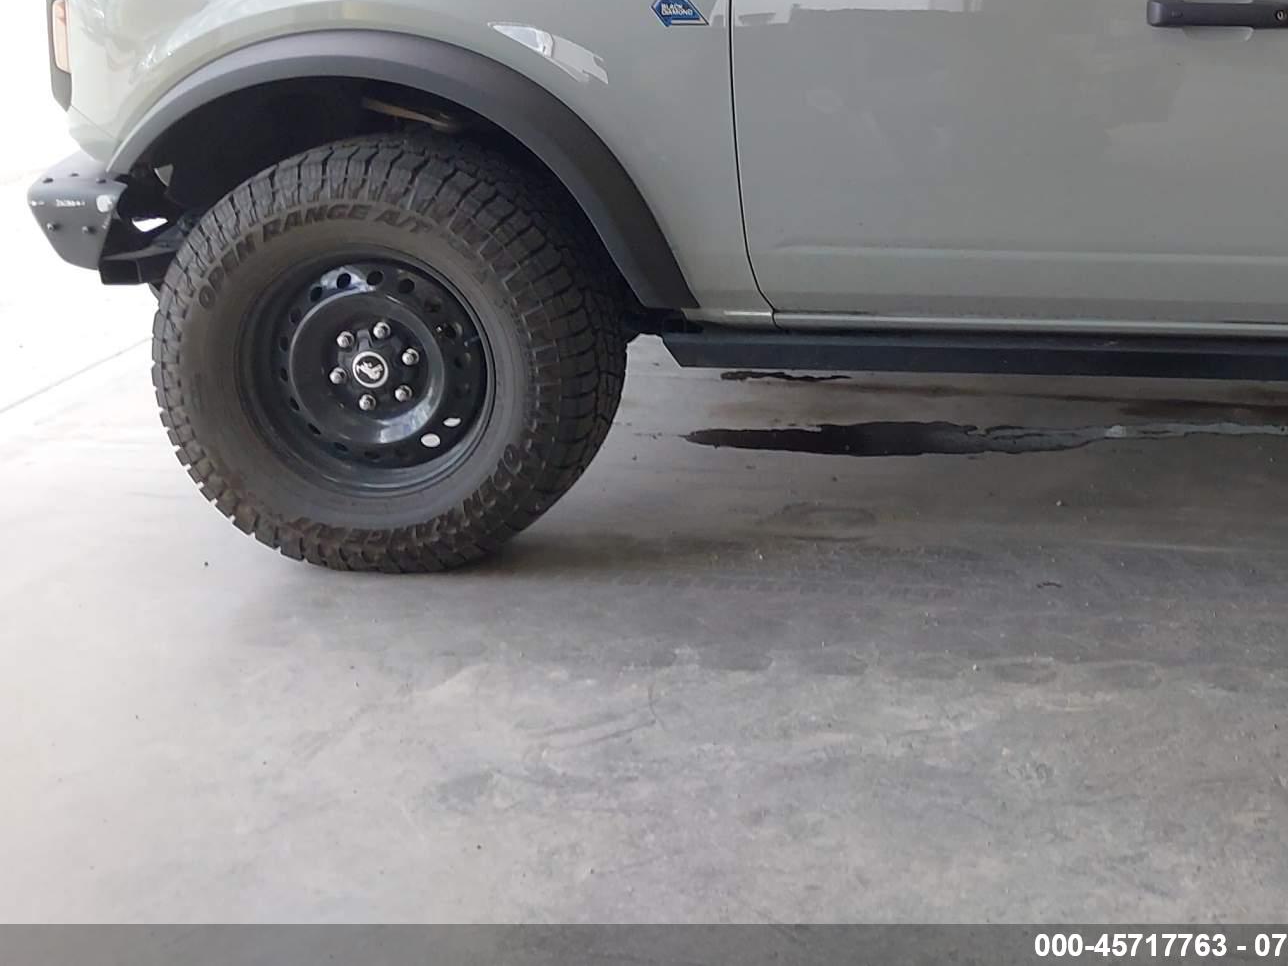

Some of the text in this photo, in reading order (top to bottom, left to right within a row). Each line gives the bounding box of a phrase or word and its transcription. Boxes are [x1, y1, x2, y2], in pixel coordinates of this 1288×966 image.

[661, 8, 693, 16] DIAMOND
[199, 239, 256, 309] OPEN
[262, 203, 373, 243] RANGE
